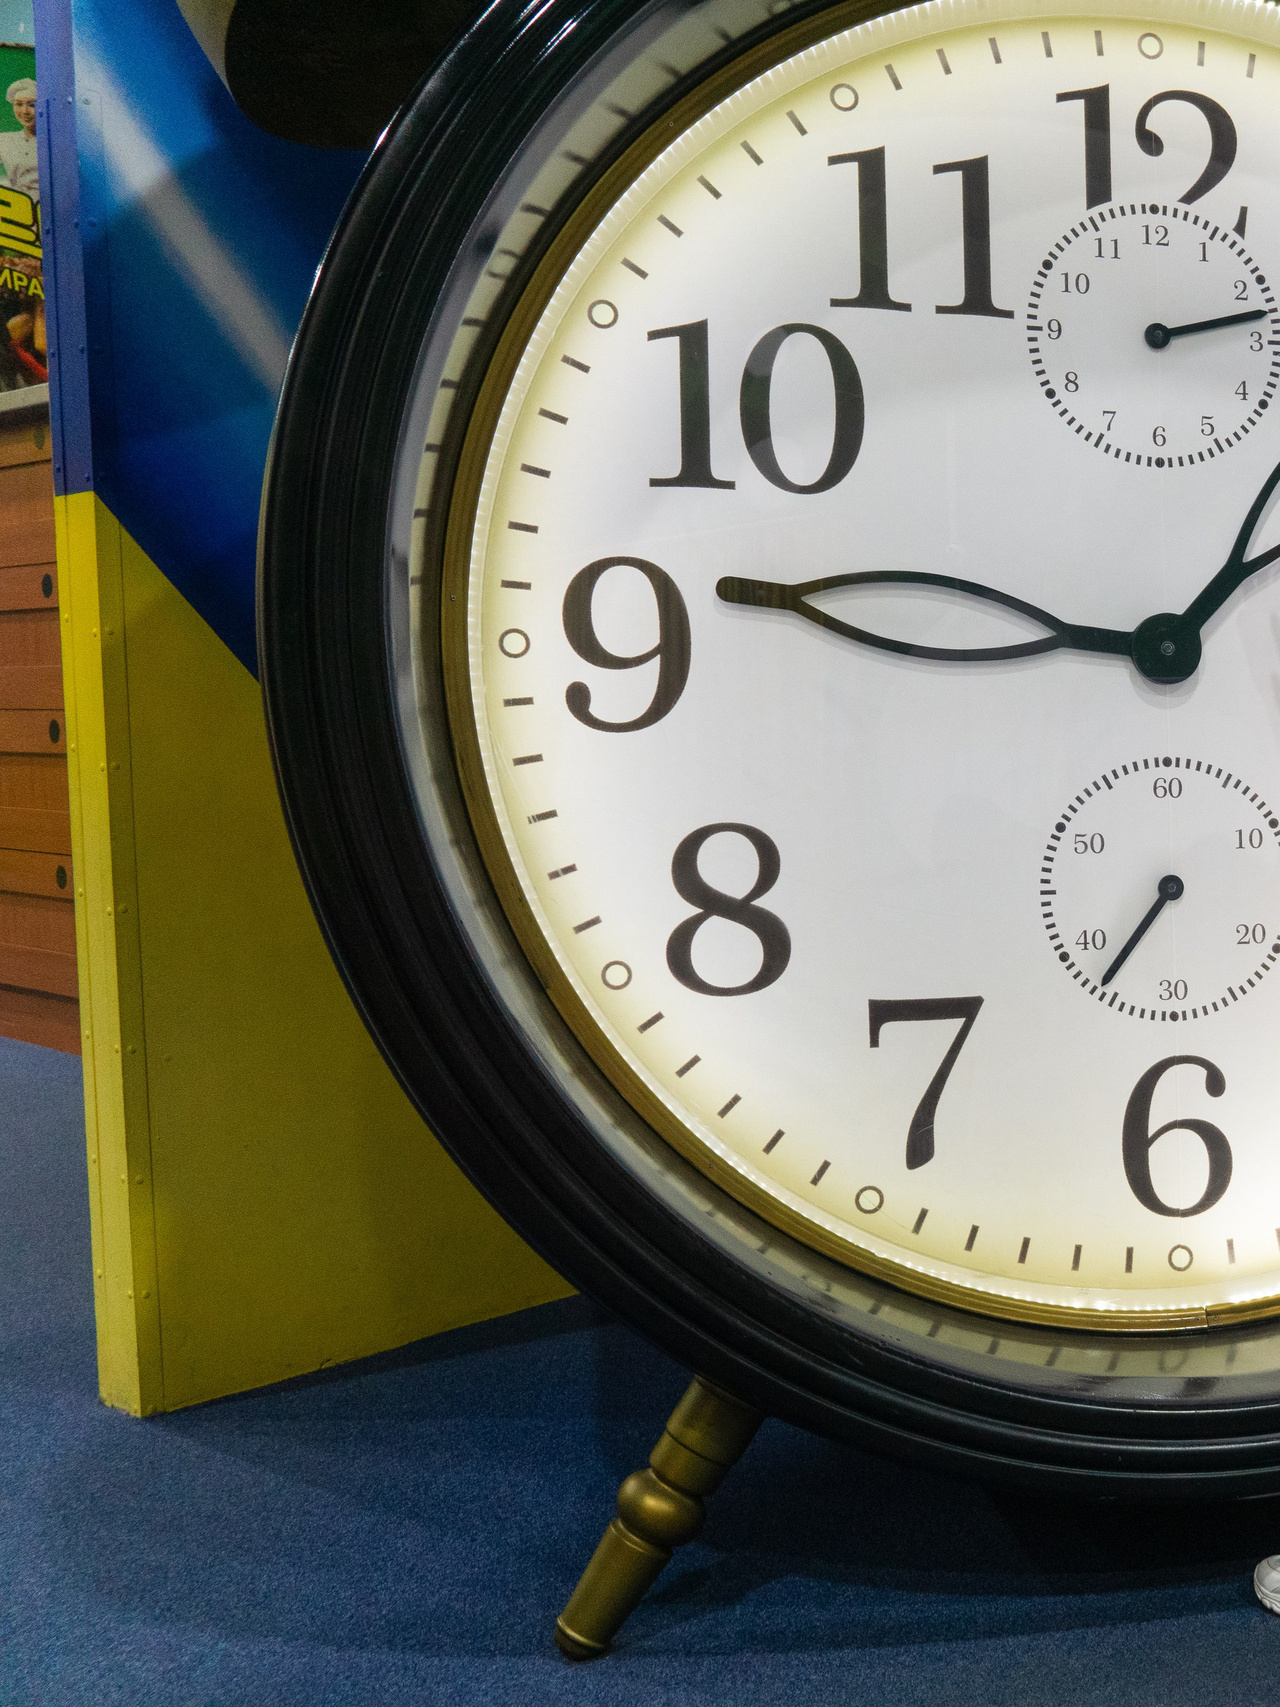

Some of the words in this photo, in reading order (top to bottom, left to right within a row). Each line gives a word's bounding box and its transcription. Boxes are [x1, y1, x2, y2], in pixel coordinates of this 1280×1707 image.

[1056, 83, 1248, 240] 12
[828, 146, 1014, 319] 11
[1142, 225, 1169, 246] 12
[1095, 238, 1120, 259] 11
[1199, 242, 1208, 262] 1
[1061, 273, 1090, 294] 10
[1234, 280, 1248, 301] 2
[1048, 319, 1062, 340] 9
[1250, 331, 1263, 351] 3
[1065, 372, 1079, 392] 8
[1235, 381, 1248, 400] 4
[648, 319, 865, 494] 10
[1103, 411, 1116, 431] 7
[1201, 416, 1214, 436] 5
[1153, 426, 1166, 446] 6
[562, 556, 691, 733] 9
[1153, 778, 1182, 798] 60
[1074, 833, 1104, 854] 50
[1235, 828, 1263, 849] 10
[666, 823, 791, 996] 8
[1076, 929, 1106, 950] 40
[1236, 923, 1266, 944] 20
[1159, 980, 1188, 1000] 30
[868, 996, 984, 1170] 7
[1122, 1055, 1232, 1218] 6
